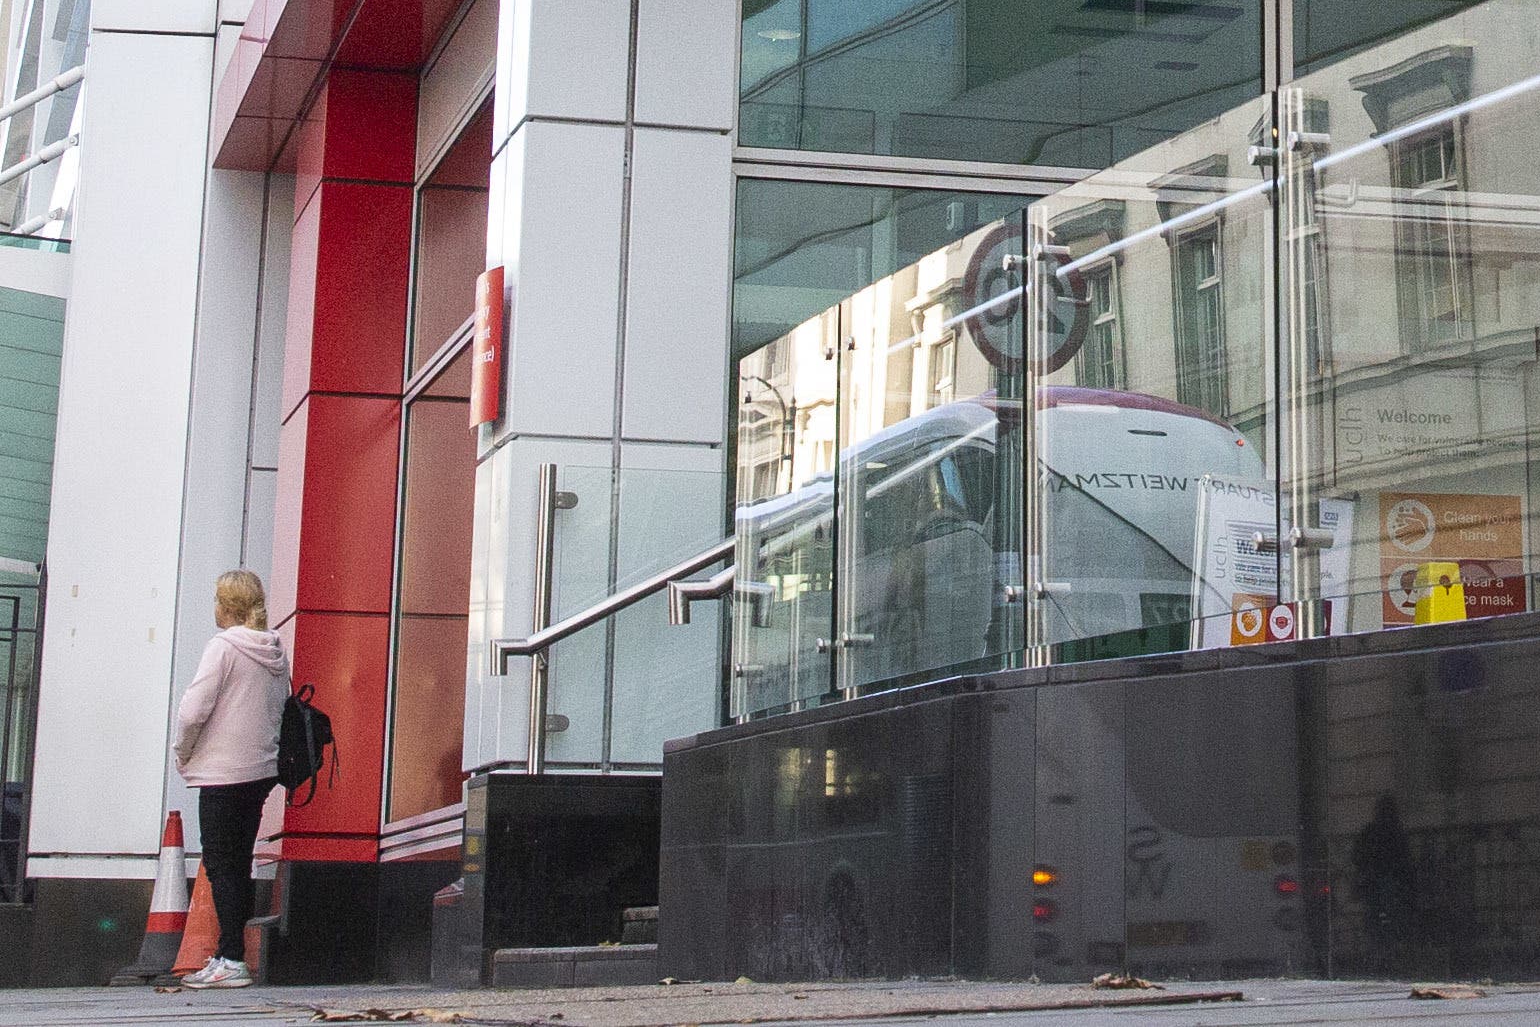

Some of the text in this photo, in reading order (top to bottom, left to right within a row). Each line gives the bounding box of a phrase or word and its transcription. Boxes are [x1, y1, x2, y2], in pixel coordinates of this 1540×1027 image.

[1376, 408, 1453, 425] Welcome
[1339, 407, 1363, 464] uclh
[1377, 434, 1391, 443] We
[1395, 436, 1415, 444] care
[1418, 434, 1432, 444] for
[1444, 511, 1516, 527] Clean your
[1460, 529, 1498, 542] hands
[1212, 535, 1228, 579] uclh
[1496, 579, 1504, 588] a
[1464, 594, 1514, 606] ce mask
